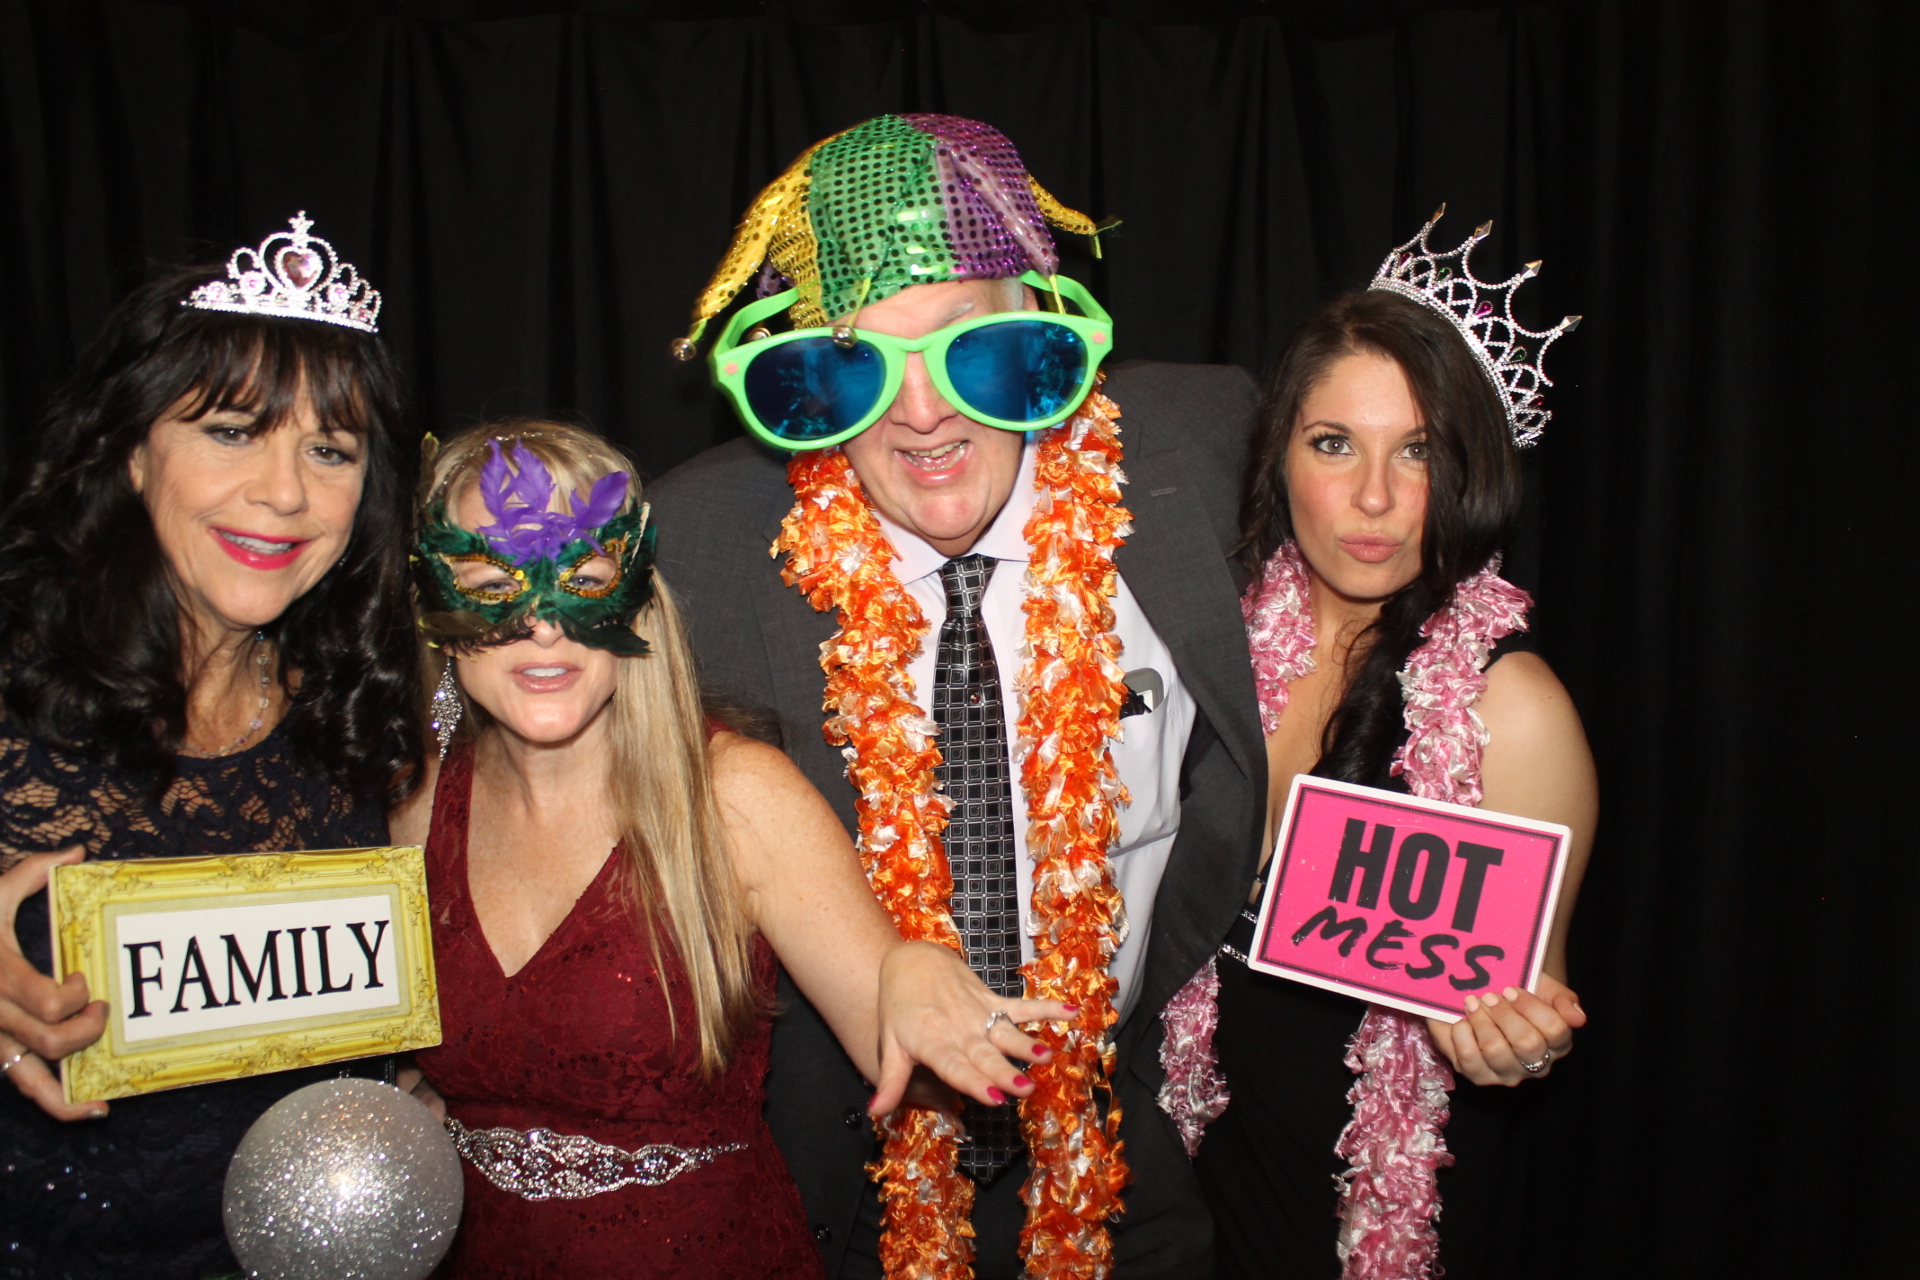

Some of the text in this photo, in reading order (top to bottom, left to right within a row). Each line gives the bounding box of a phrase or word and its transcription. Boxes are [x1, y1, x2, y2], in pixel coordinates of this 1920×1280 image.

[1327, 817, 1505, 934] HOT
[123, 919, 390, 1019] FAMILY
[1291, 905, 1505, 992] MESS
